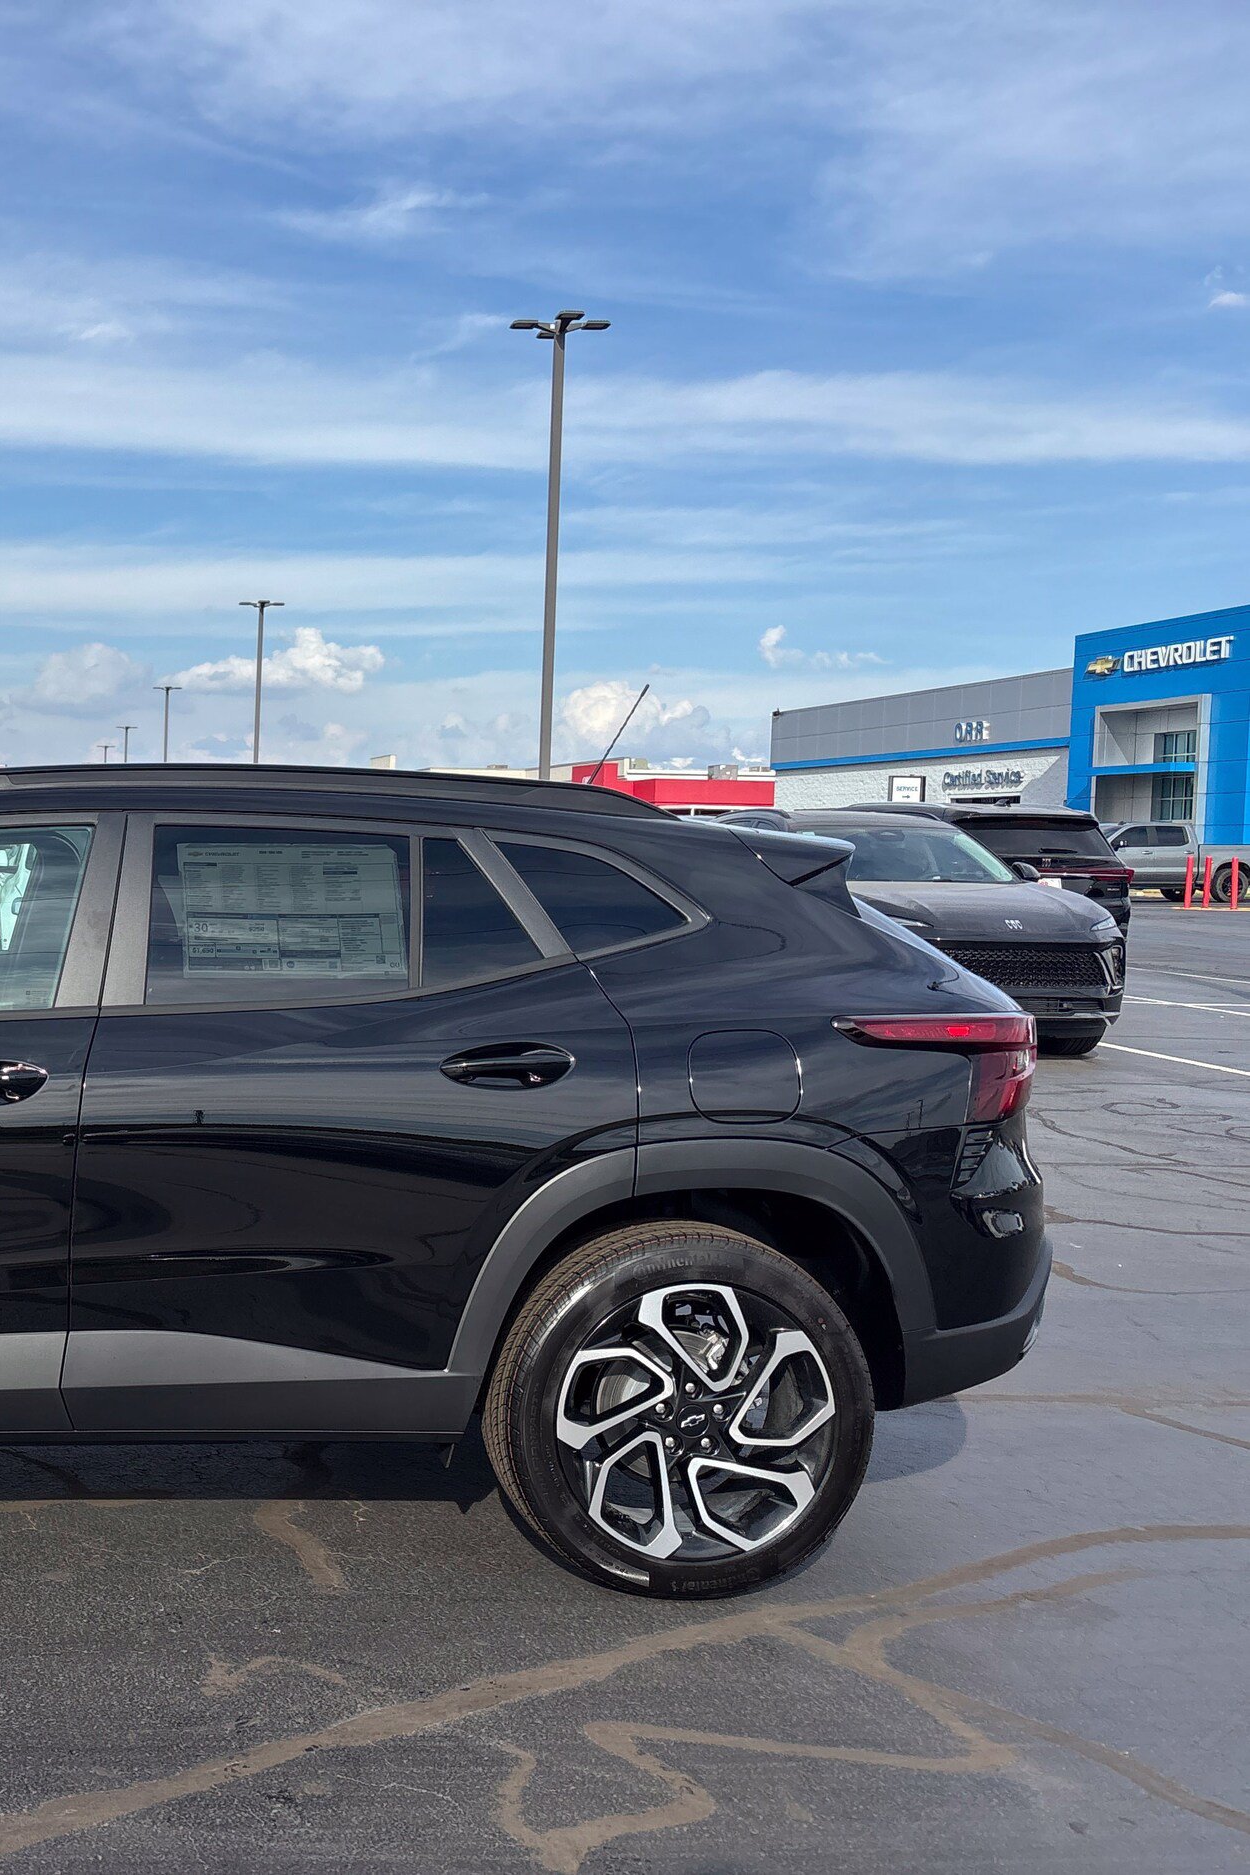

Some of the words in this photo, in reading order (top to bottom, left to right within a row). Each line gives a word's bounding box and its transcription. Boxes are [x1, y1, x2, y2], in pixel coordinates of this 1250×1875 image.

[1123, 635, 1234, 672] CHEVROLET
[943, 770, 982, 786] Certified
[985, 768, 1025, 785] Service
